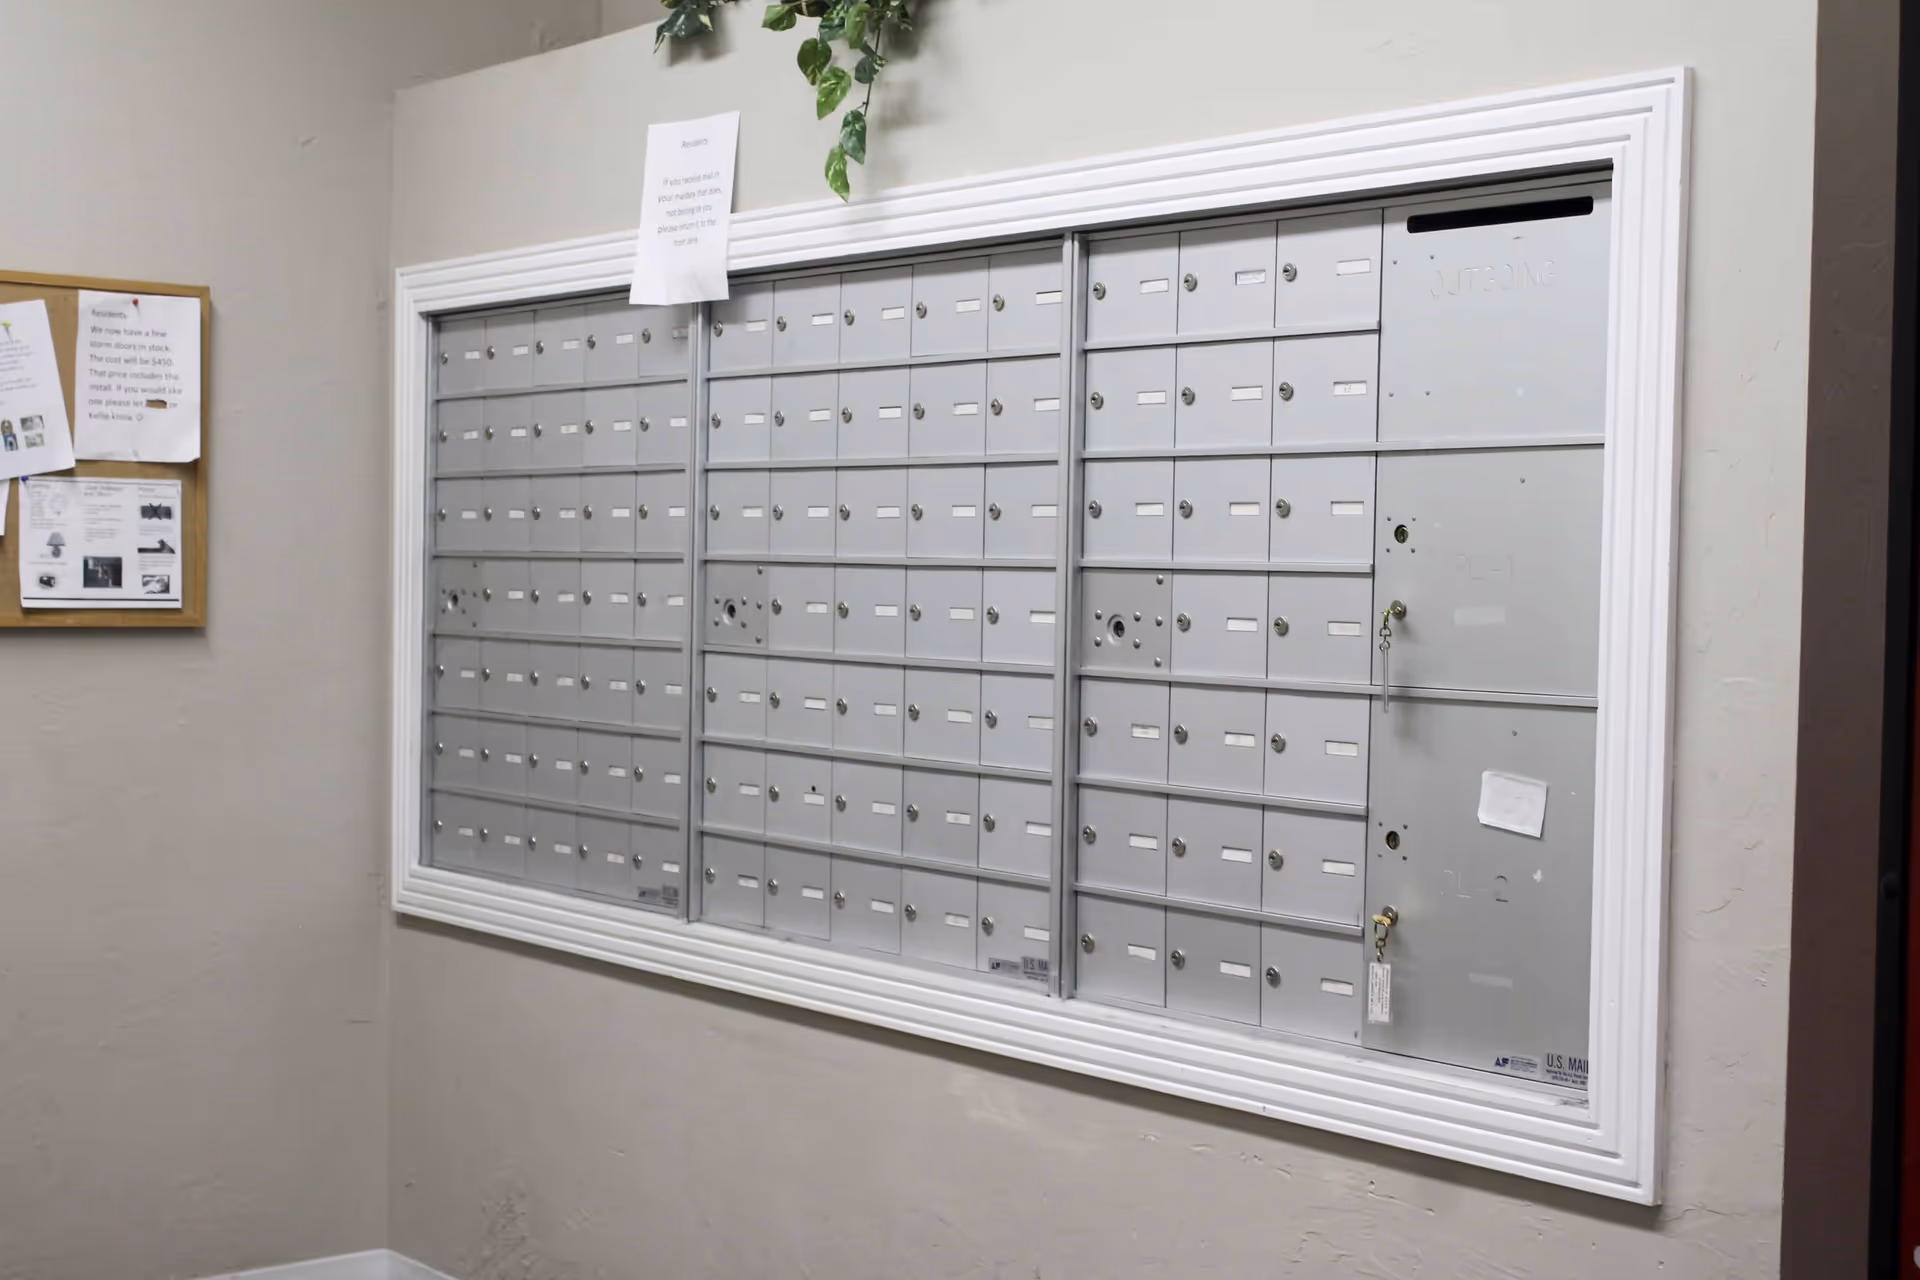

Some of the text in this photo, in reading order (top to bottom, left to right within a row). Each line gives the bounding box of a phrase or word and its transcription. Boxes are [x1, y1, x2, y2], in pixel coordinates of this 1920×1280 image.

[90, 325, 103, 333] We
[123, 328, 142, 336] have
[151, 329, 167, 337] few
[114, 342, 136, 350] doors
[89, 353, 103, 362] The
[105, 356, 122, 364] cost
[140, 357, 149, 365] be
[89, 368, 106, 377] That
[108, 370, 127, 378] price
[124, 386, 138, 394] you
[105, 399, 131, 407] please
[1546, 1052, 1565, 1070] U.S.
